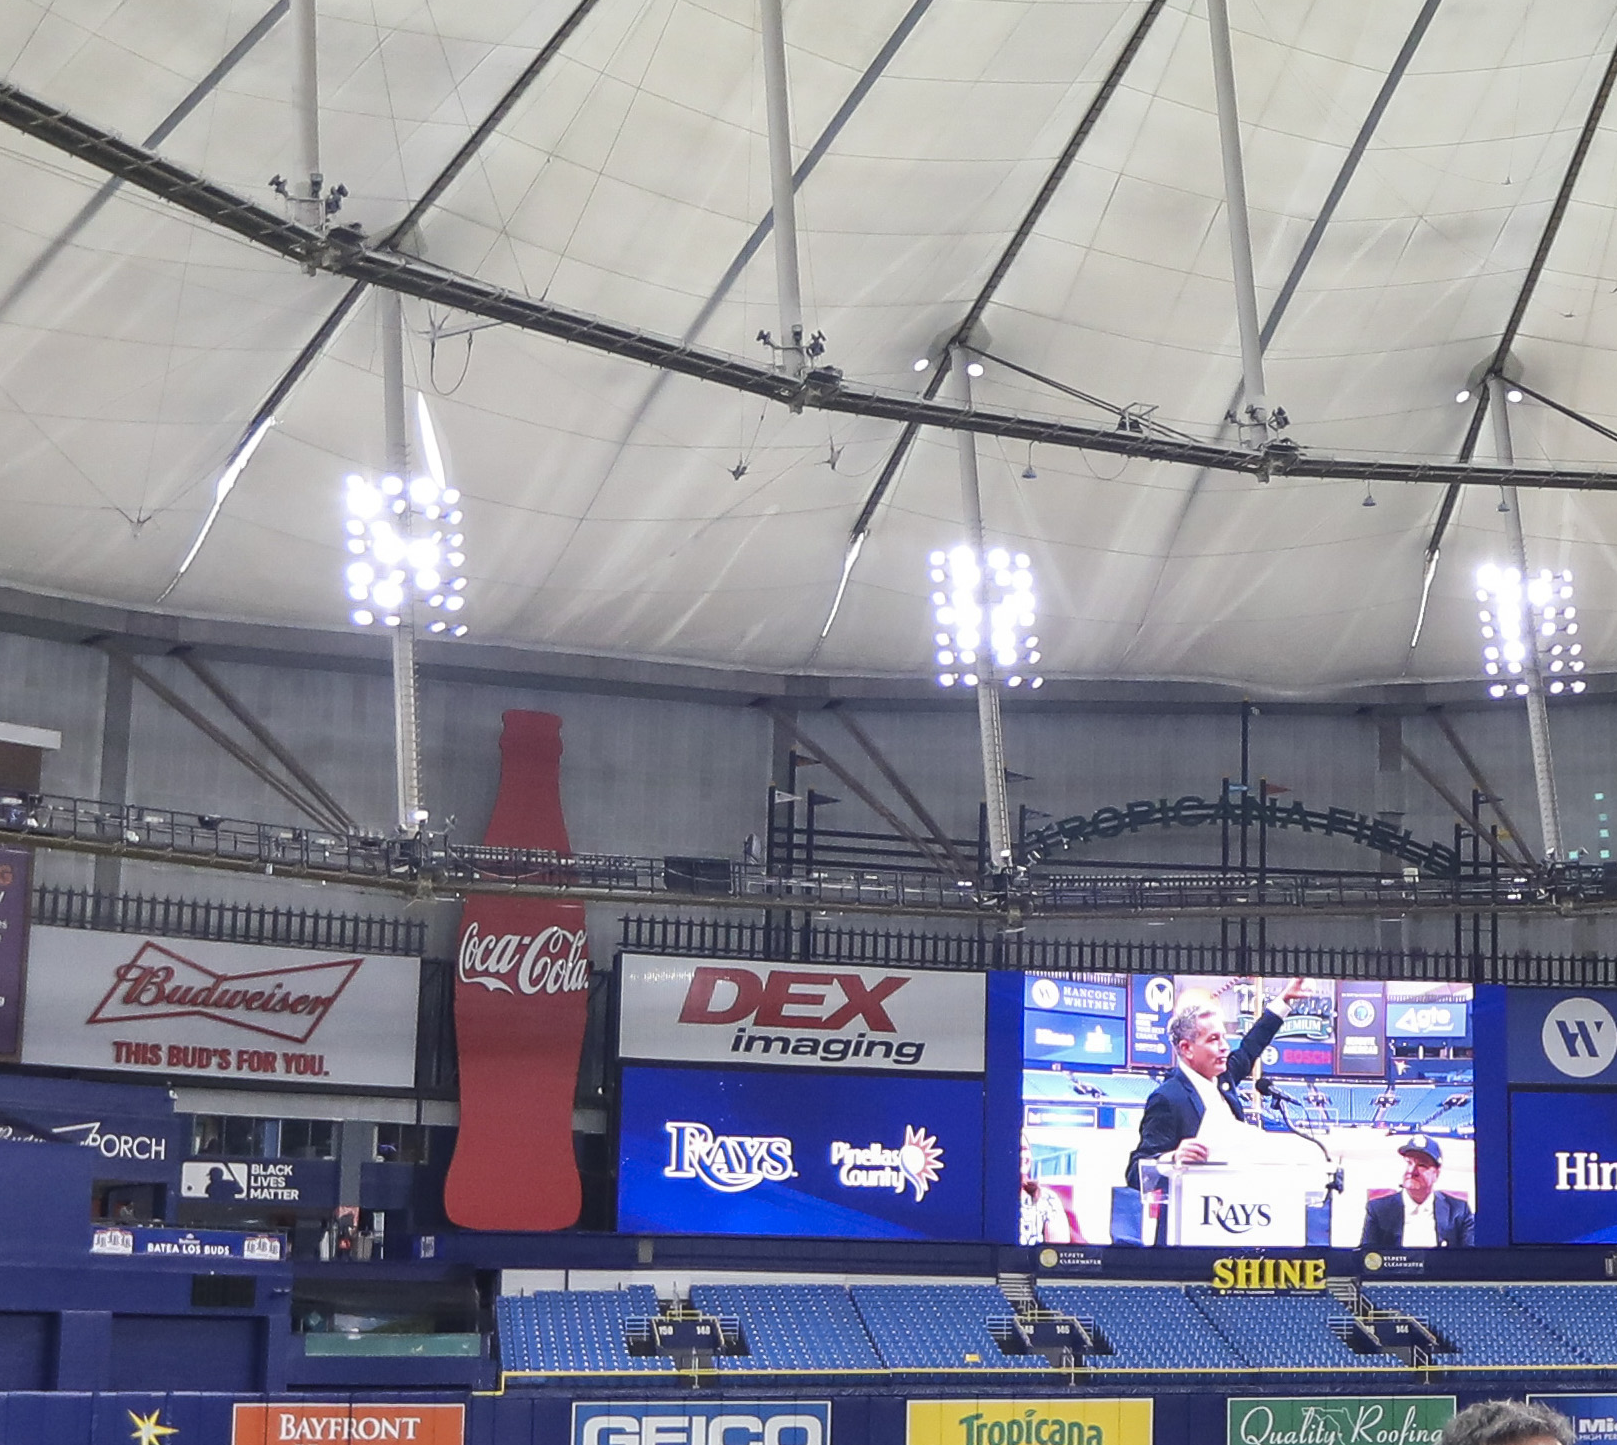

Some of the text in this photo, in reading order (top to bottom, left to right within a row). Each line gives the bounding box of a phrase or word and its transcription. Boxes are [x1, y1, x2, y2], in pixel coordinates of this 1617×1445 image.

[116, 962, 336, 1016] Budweiser
[678, 966, 912, 1034] DEX
[1063, 986, 1117, 1002] HANCOCK
[1063, 997, 1117, 1011] WHITNEY
[113, 1040, 331, 1076] THIS BUD'S FOR YOU.
[731, 1027, 926, 1066] imaging
[665, 1121, 794, 1193] RAYS
[831, 1141, 902, 1166] Pinellas
[250, 1175, 287, 1188] LIVES
[251, 1163, 293, 1176] BLACK
[840, 1165, 905, 1194] County
[249, 1188, 300, 1201] MATTER
[1200, 1195, 1272, 1235] RAYS
[146, 1242, 230, 1256] BATEA LOS BUDS
[1211, 1258, 1327, 1289] SHINE
[278, 1413, 422, 1441] BAYFRONT
[1578, 1433, 1594, 1441] HIGH
